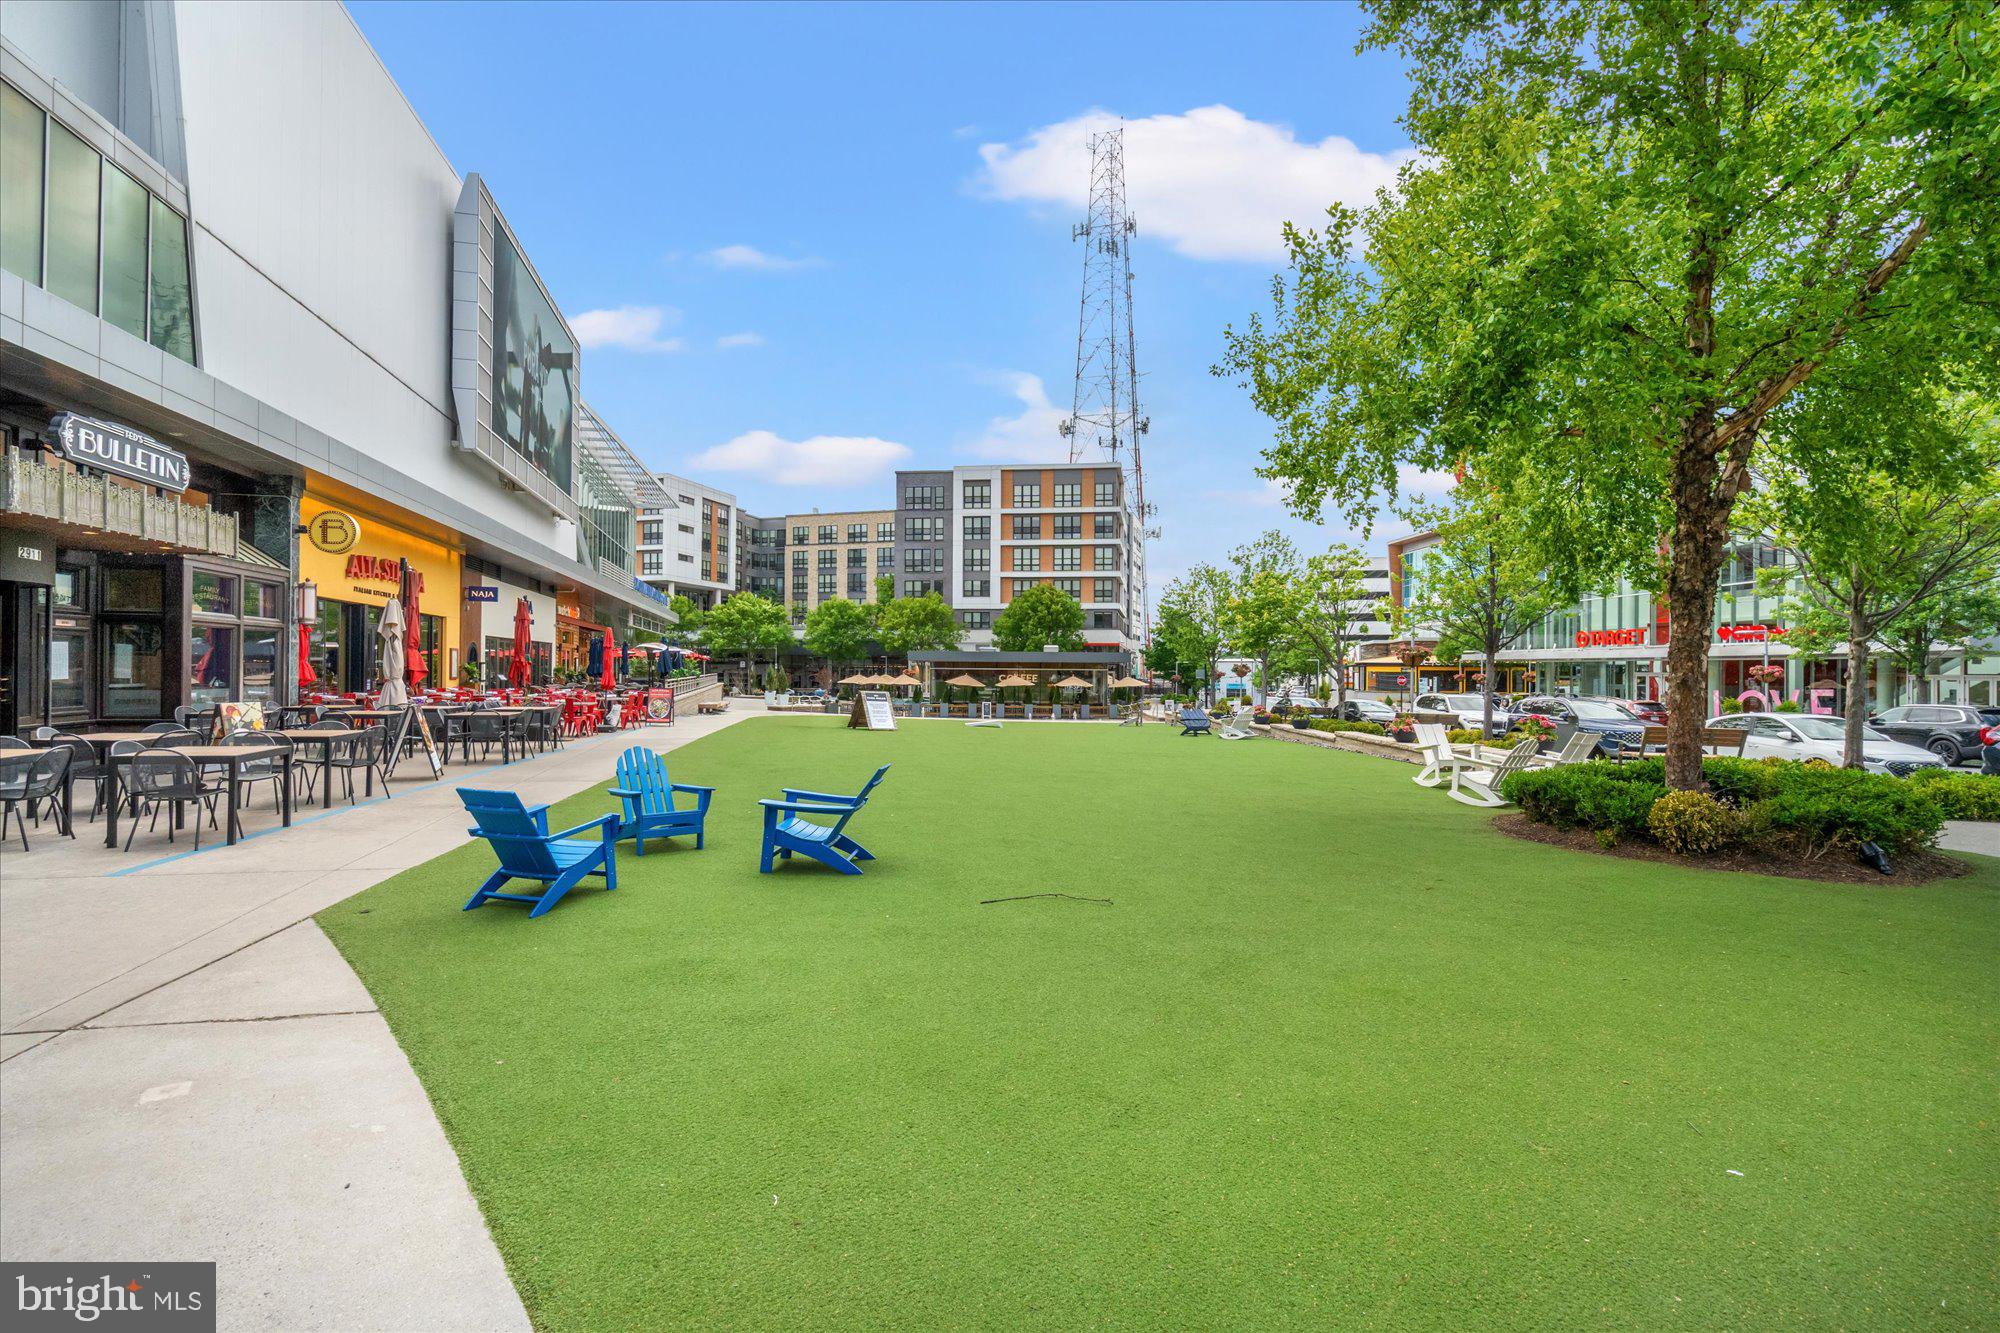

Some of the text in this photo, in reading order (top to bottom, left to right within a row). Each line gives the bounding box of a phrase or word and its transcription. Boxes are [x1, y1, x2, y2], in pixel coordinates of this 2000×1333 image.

[78, 428, 180, 481] BULLETIN
[20, 547, 40, 560] 2911
[1589, 627, 1647, 646] TARGET
